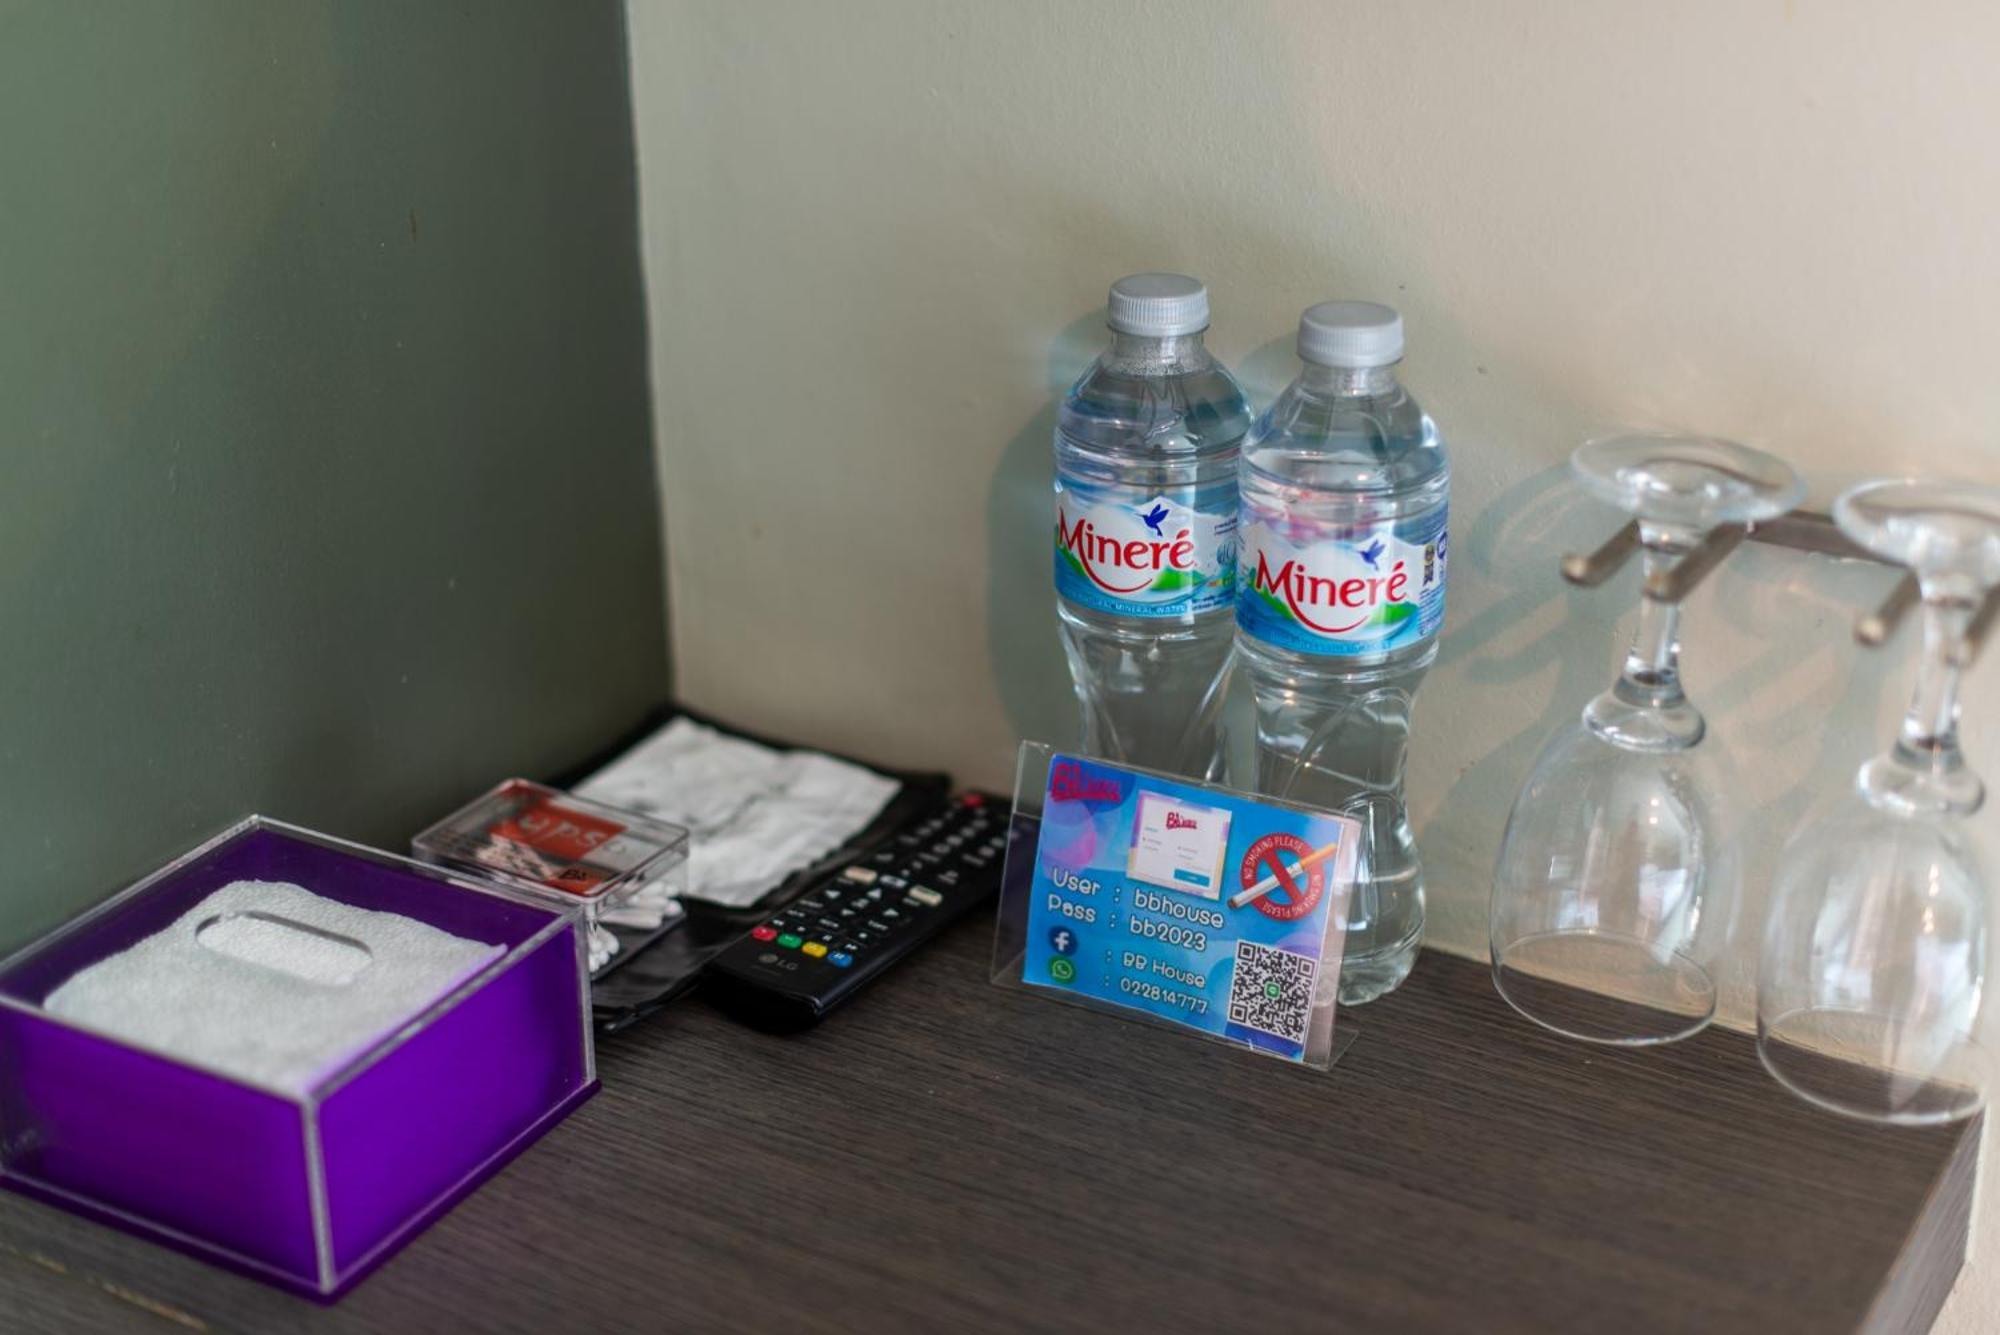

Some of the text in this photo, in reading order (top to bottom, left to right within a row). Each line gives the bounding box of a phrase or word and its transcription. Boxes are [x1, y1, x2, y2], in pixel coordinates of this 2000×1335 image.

[1057, 508, 1195, 592] Mineré
[1255, 549, 1408, 633] Mineré
[1274, 836, 1304, 851] PLEASE
[1053, 868, 1100, 895] User
[1135, 889, 1224, 928] bbhouse
[1048, 894, 1096, 923] Pass
[1130, 916, 1206, 951] bb2023
[777, 960, 798, 970] LG
[1123, 952, 1148, 970] BB
[1152, 960, 1206, 988] House
[1120, 978, 1208, 1015] 022814777
